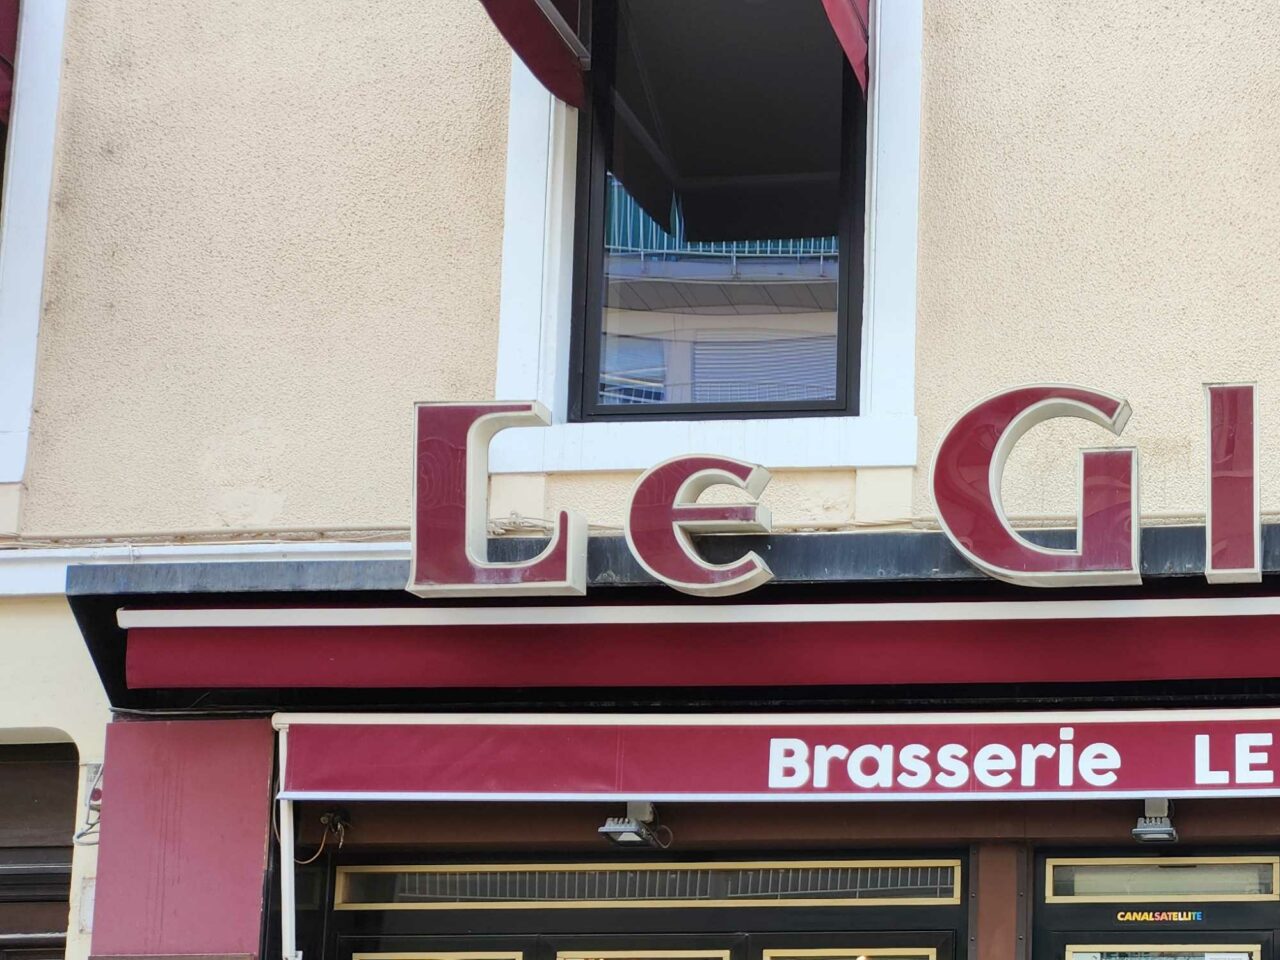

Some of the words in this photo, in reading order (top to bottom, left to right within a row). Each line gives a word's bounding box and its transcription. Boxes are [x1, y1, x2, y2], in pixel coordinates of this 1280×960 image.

[405, 400, 775, 598] Le
[767, 727, 1123, 790] Brasserie
[1194, 733, 1274, 784] LE
[1116, 911, 1202, 921] CANALSATELLITE
